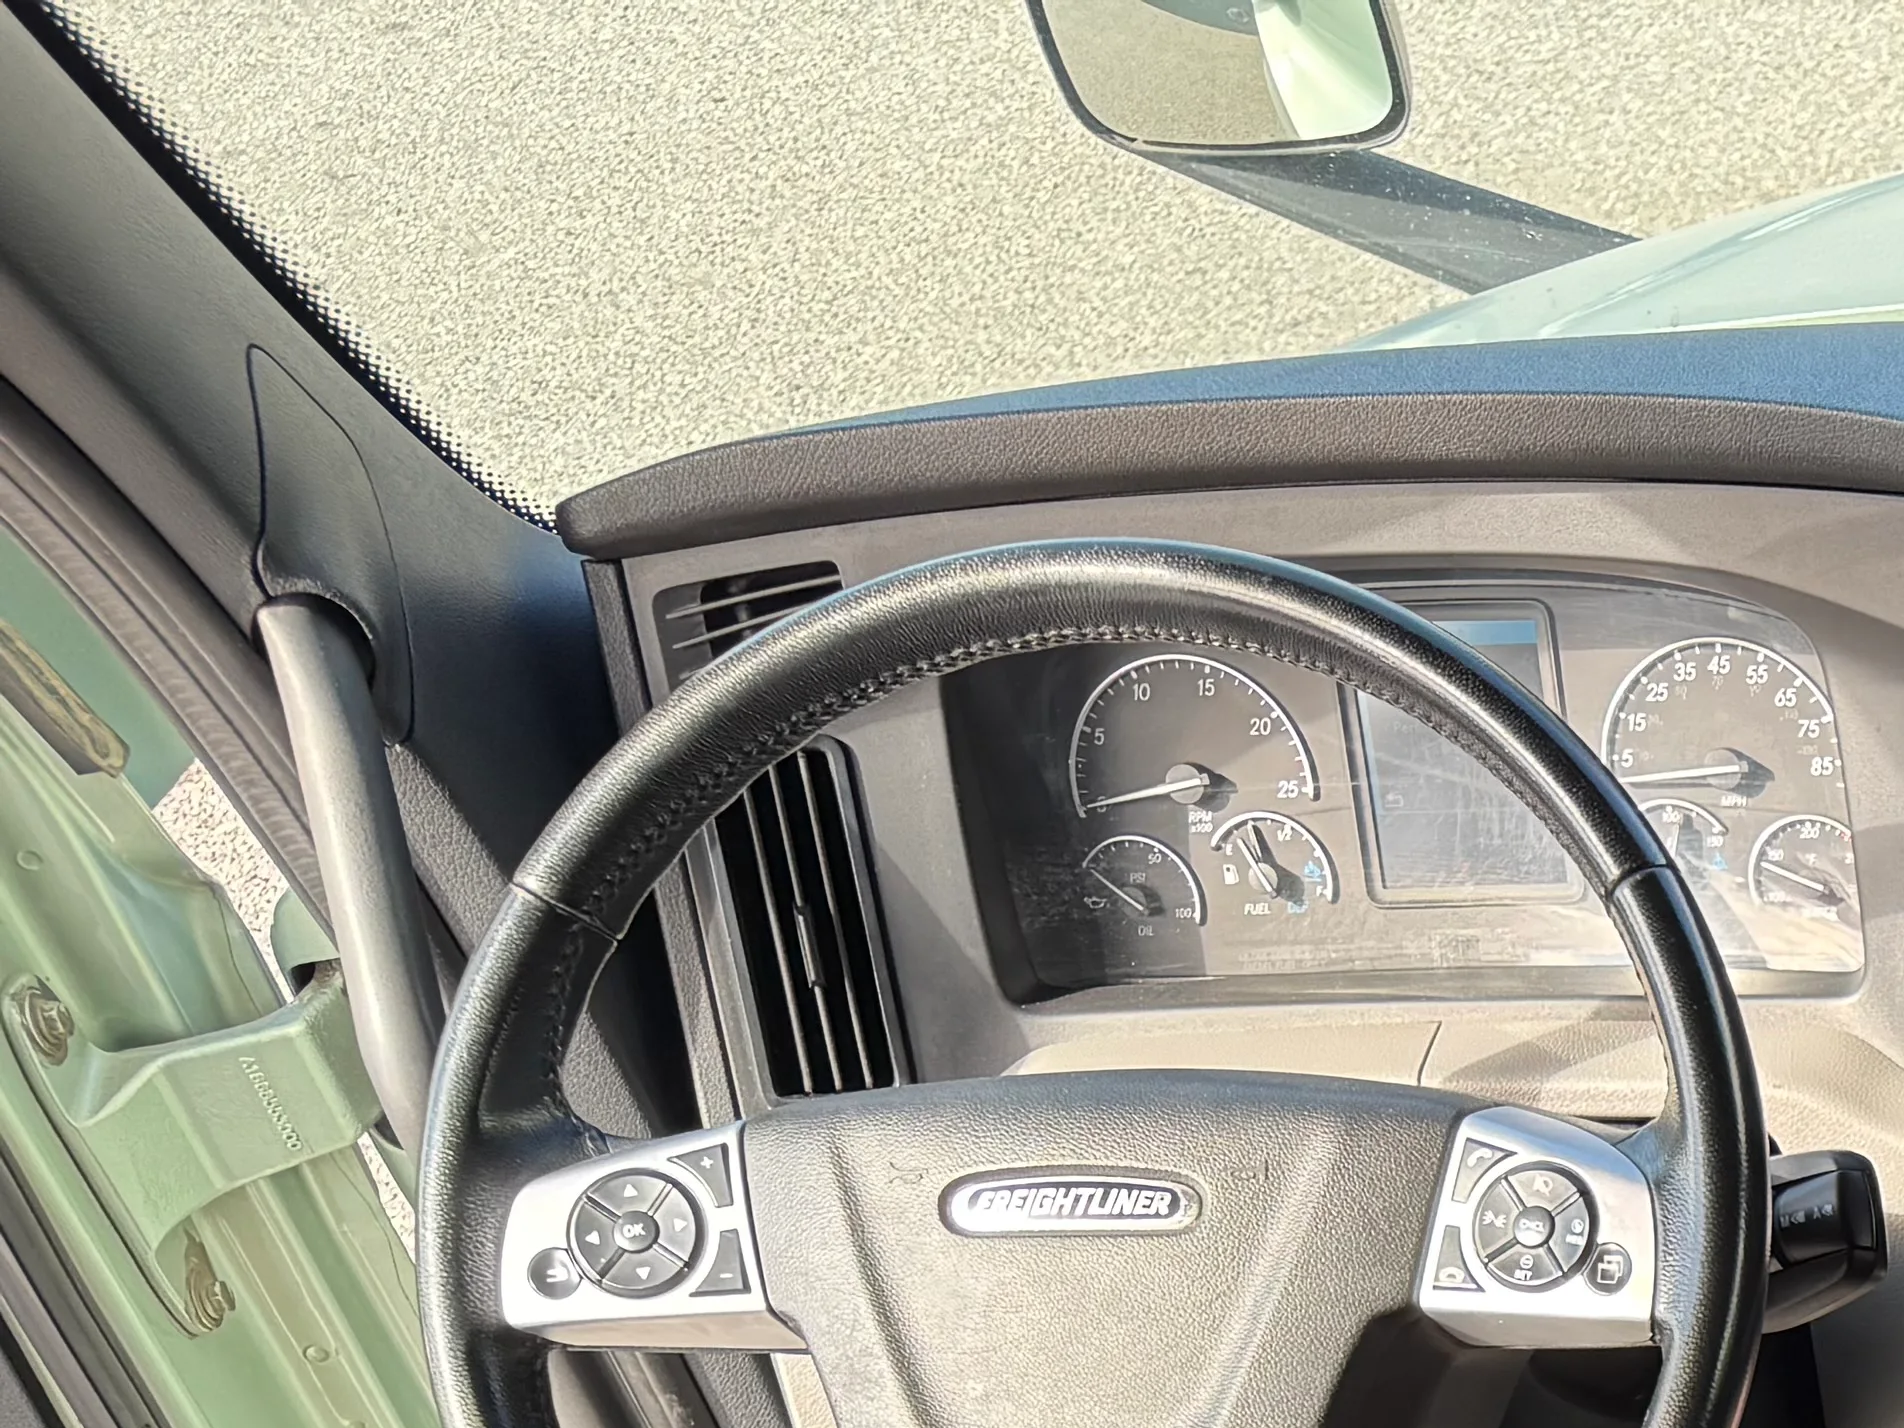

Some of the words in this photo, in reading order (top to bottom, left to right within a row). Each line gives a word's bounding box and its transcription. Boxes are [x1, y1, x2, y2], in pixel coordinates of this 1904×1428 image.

[1673, 662, 1697, 681] 35
[1707, 655, 1731, 674] 45
[1746, 665, 1768, 685] 55
[1133, 682, 1150, 701] 10
[1197, 679, 1215, 696] 15
[1645, 683, 1668, 702] 25
[1774, 688, 1797, 707] 65
[1250, 717, 1271, 736] 20
[1627, 713, 1646, 732] 15
[1798, 720, 1820, 738] 75
[1094, 728, 1105, 745] 5
[1620, 749, 1633, 768] 5
[1810, 757, 1834, 776] 85
[1277, 780, 1299, 799] 25
[1721, 796, 1748, 807] MPH
[1188, 811, 1212, 824] RPM
[1800, 828, 1819, 839] 200
[1225, 843, 1233, 855] E
[1148, 853, 1162, 864] 50
[1130, 872, 1147, 883] PSI
[1175, 908, 1191, 919] 100
[1244, 903, 1271, 915] FUEL
[1138, 925, 1154, 936] OIL
[977, 1186, 1171, 1217] FREIGHTLINER
[622, 1223, 646, 1238] OK
